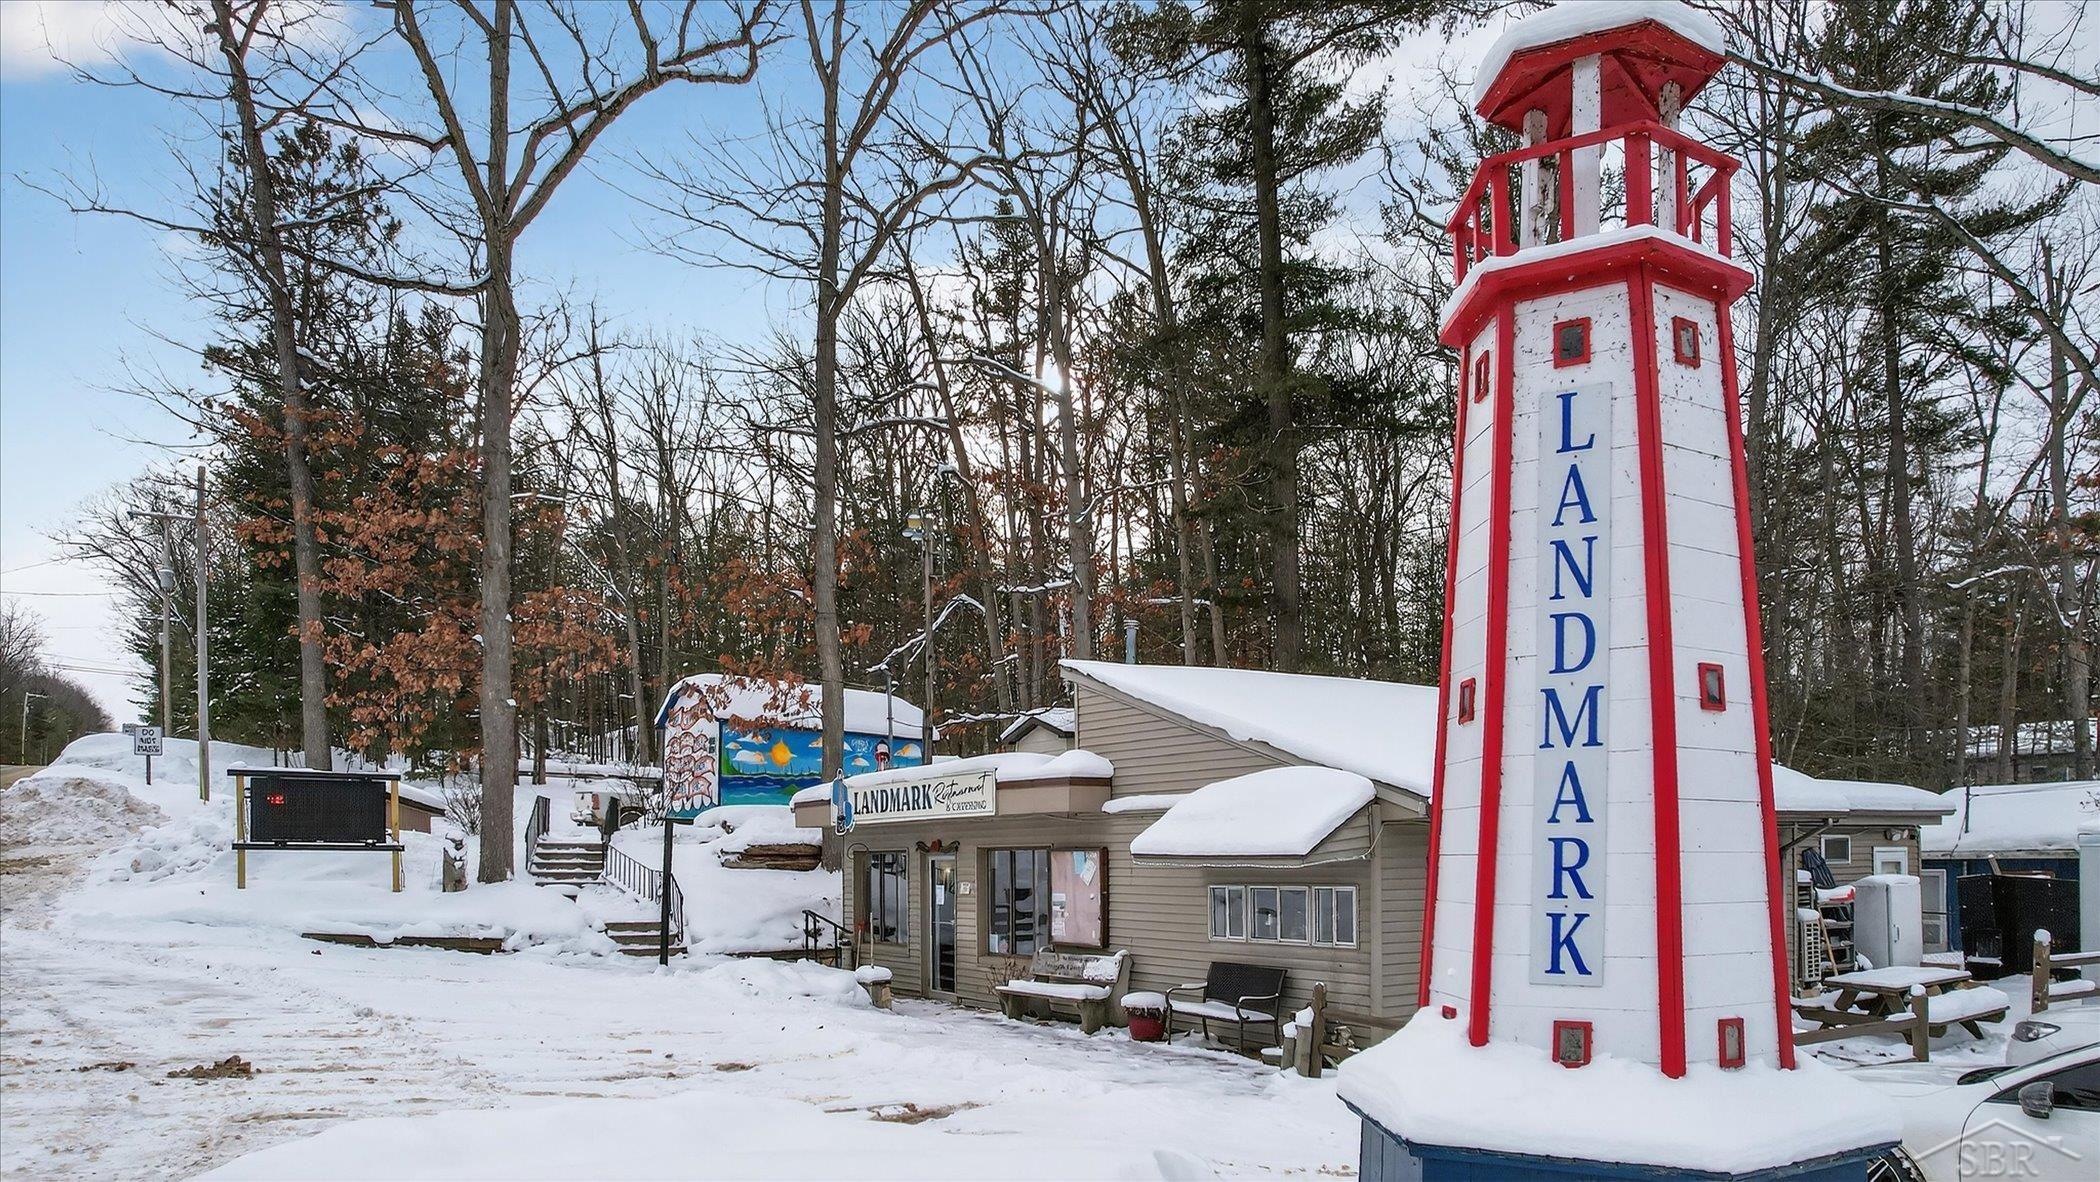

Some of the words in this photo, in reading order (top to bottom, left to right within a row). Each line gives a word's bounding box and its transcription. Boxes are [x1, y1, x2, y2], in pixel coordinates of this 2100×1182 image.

[1538, 391, 1605, 976] LANDMARK
[142, 728, 154, 736] DO
[853, 783, 933, 815] LANDMARK
[932, 771, 992, 804] Restaurant
[945, 801, 951, 812] &
